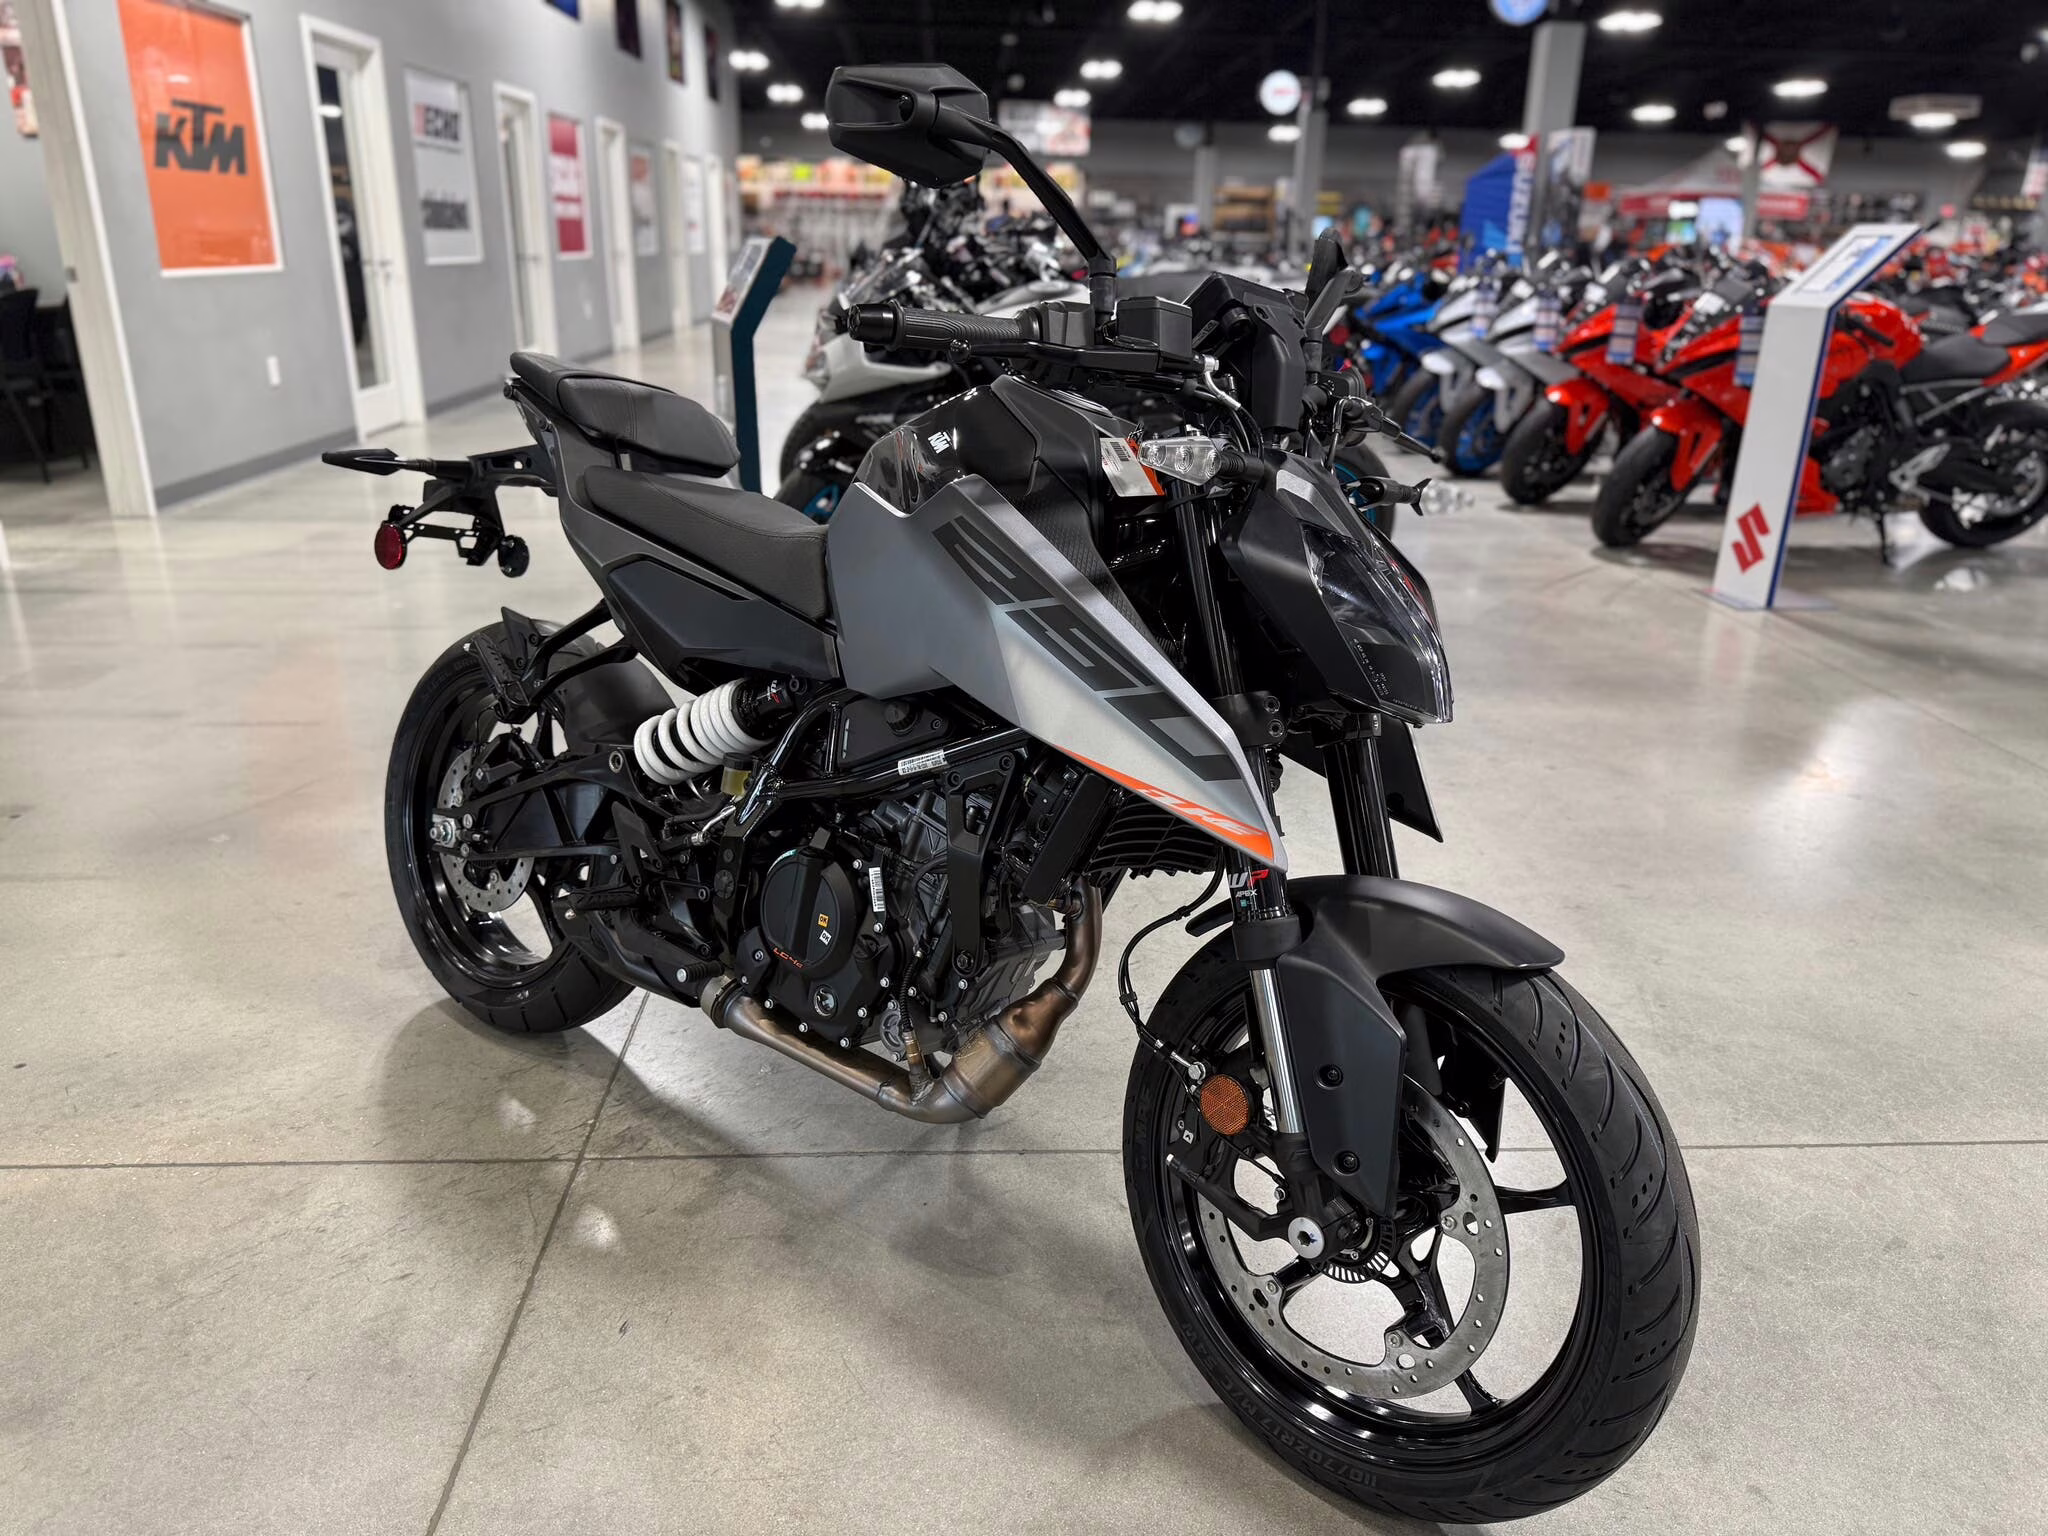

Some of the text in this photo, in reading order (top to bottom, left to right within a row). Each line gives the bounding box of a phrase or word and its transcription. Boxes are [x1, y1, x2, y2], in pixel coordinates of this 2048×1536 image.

[154, 98, 247, 175] KTM
[927, 431, 951, 454] KTM
[931, 514, 1242, 782] 250
[1228, 869, 1269, 889] WP
[1235, 889, 1258, 898] APEX
